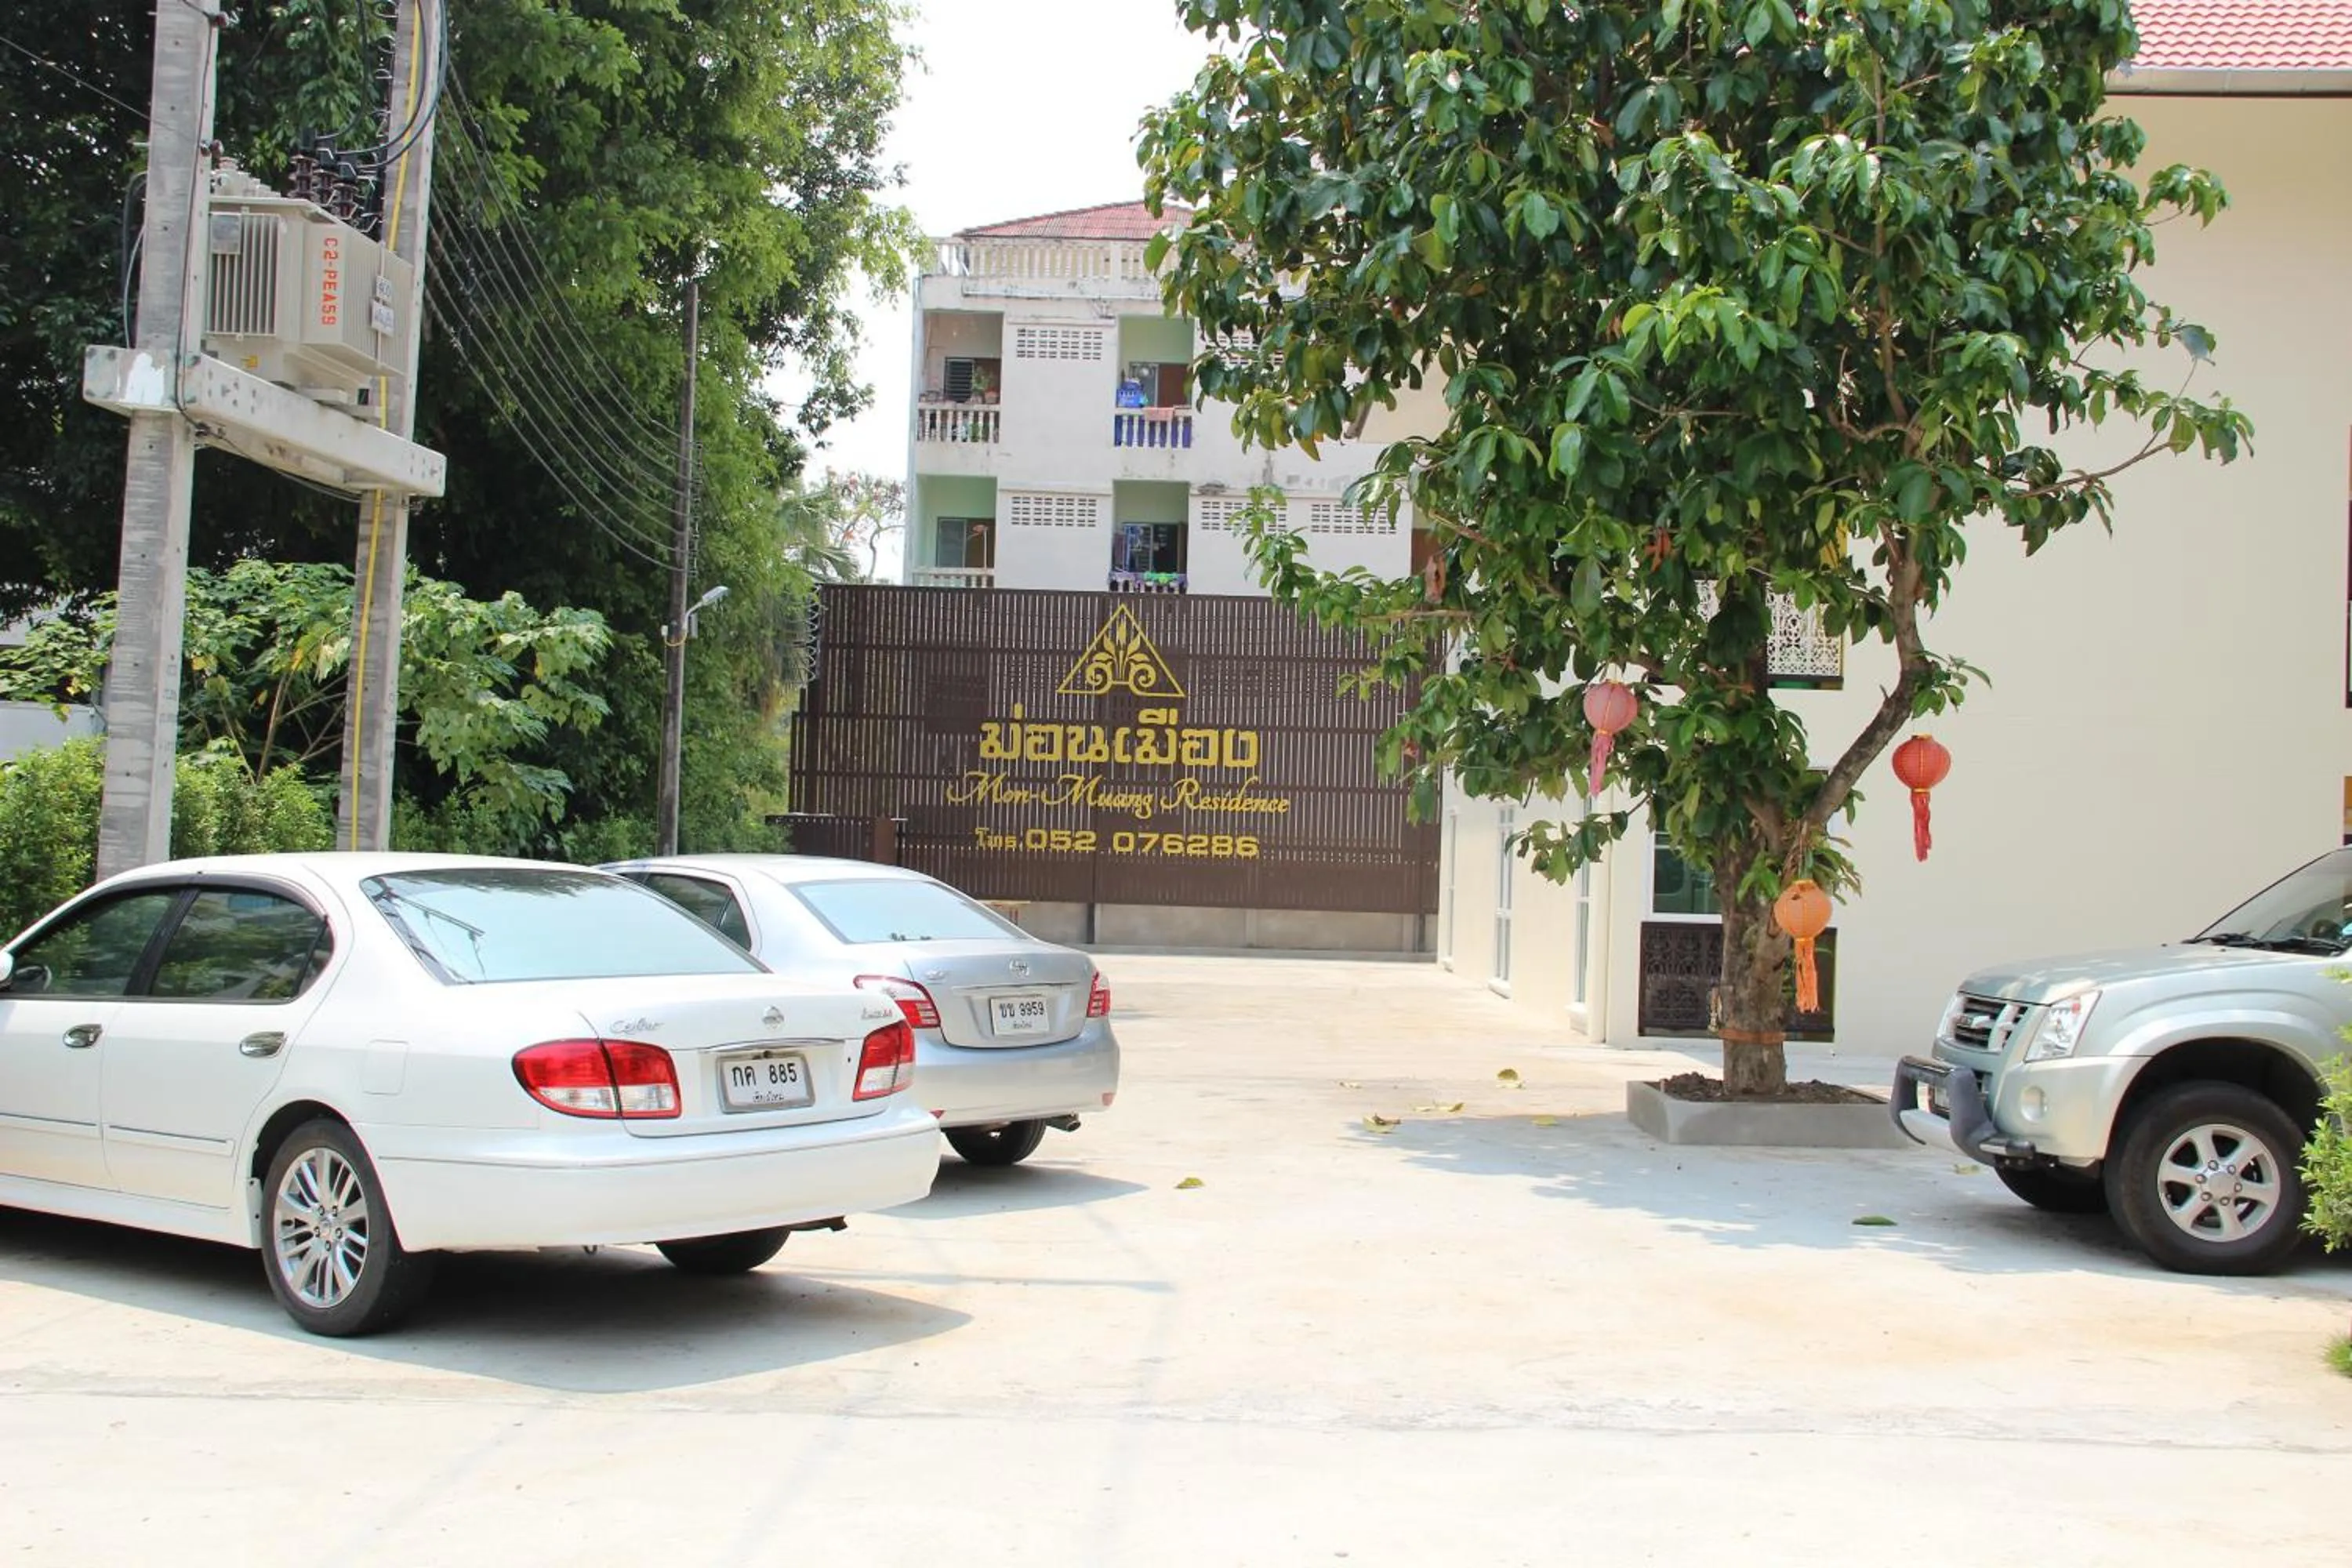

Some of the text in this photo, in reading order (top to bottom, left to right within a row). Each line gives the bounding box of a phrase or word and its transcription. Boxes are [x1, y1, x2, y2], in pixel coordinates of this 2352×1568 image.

[980, 702, 1258, 768] ม่อนเมือง
[1160, 775, 1289, 813] Residence
[1025, 828, 1097, 852] 052
[1112, 831, 1259, 857] 076286
[769, 1062, 797, 1084] 885
